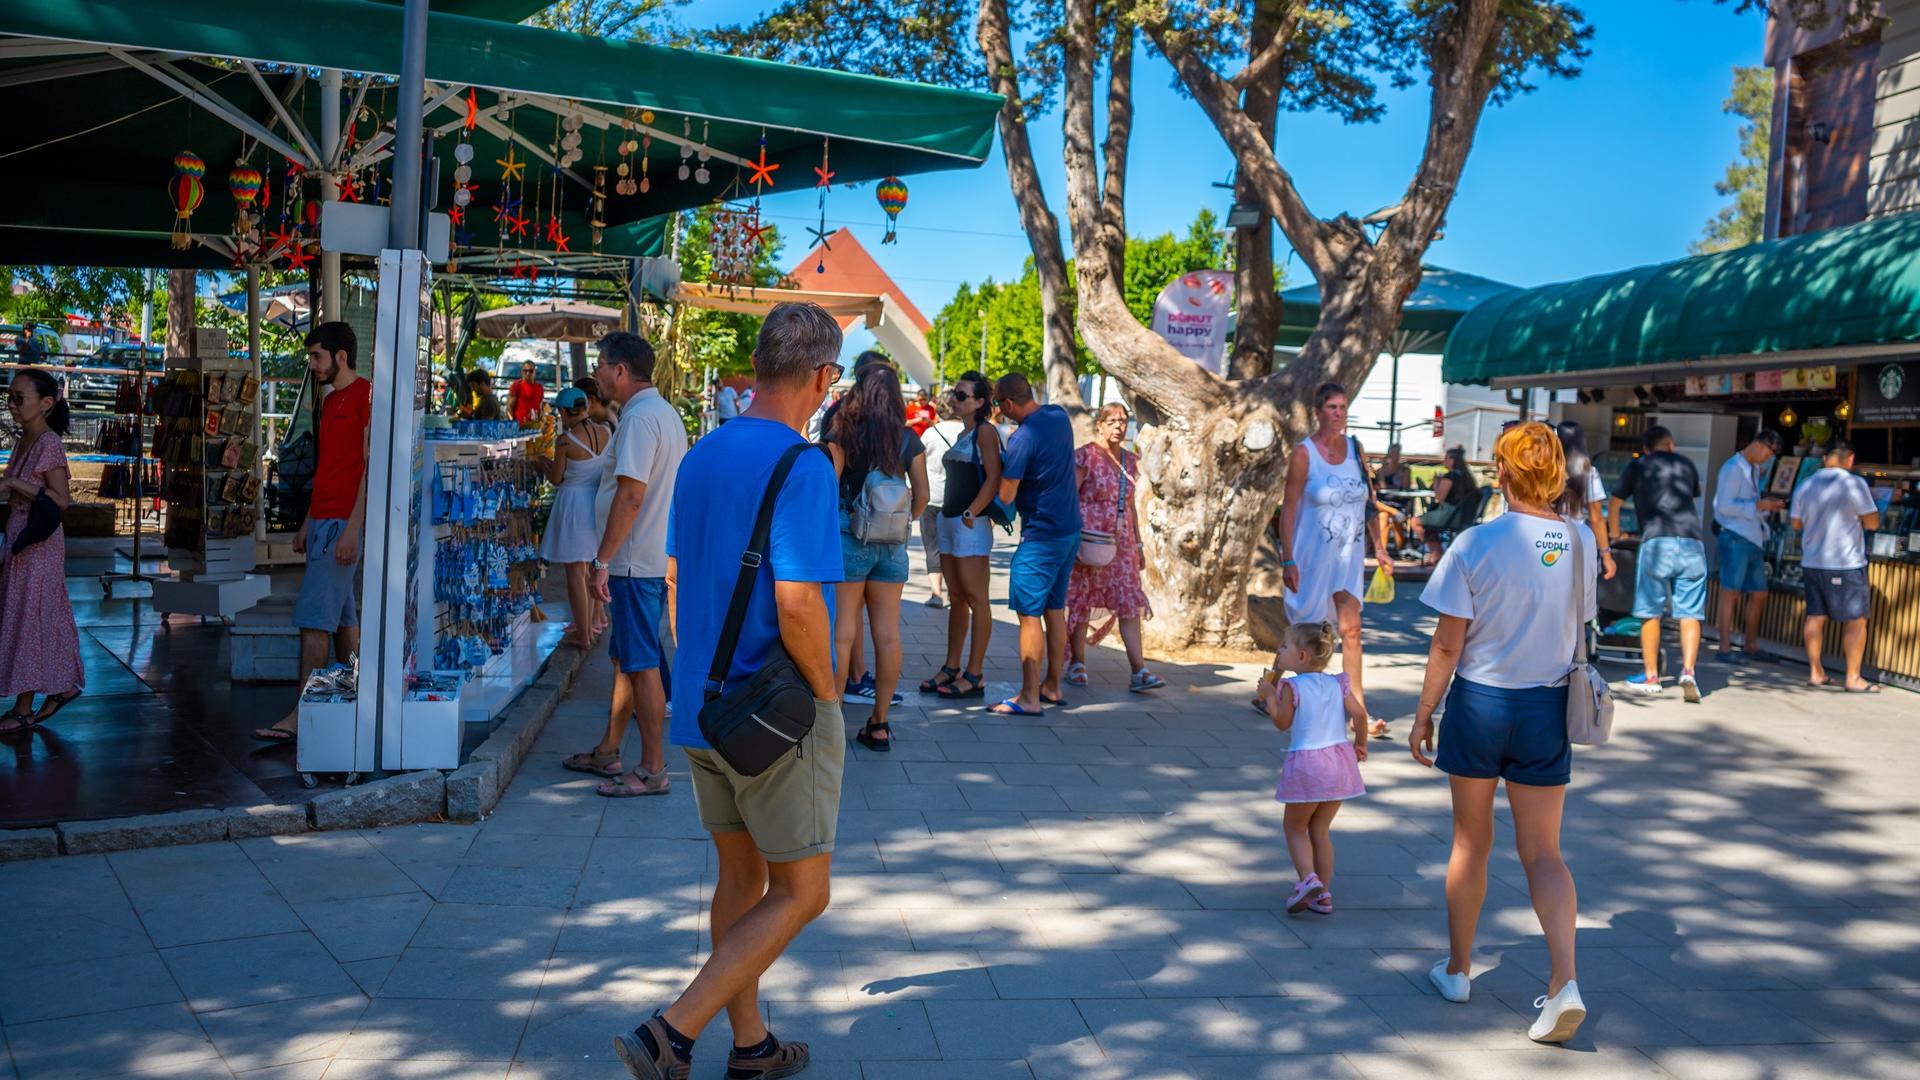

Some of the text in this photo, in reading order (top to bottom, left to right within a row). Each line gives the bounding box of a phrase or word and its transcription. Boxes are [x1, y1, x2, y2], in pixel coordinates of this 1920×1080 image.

[1168, 312, 1213, 322] DONUT
[1168, 324, 1212, 337] happy
[1544, 531, 1563, 539] AVO
[1535, 540, 1570, 551] CUDDLE
